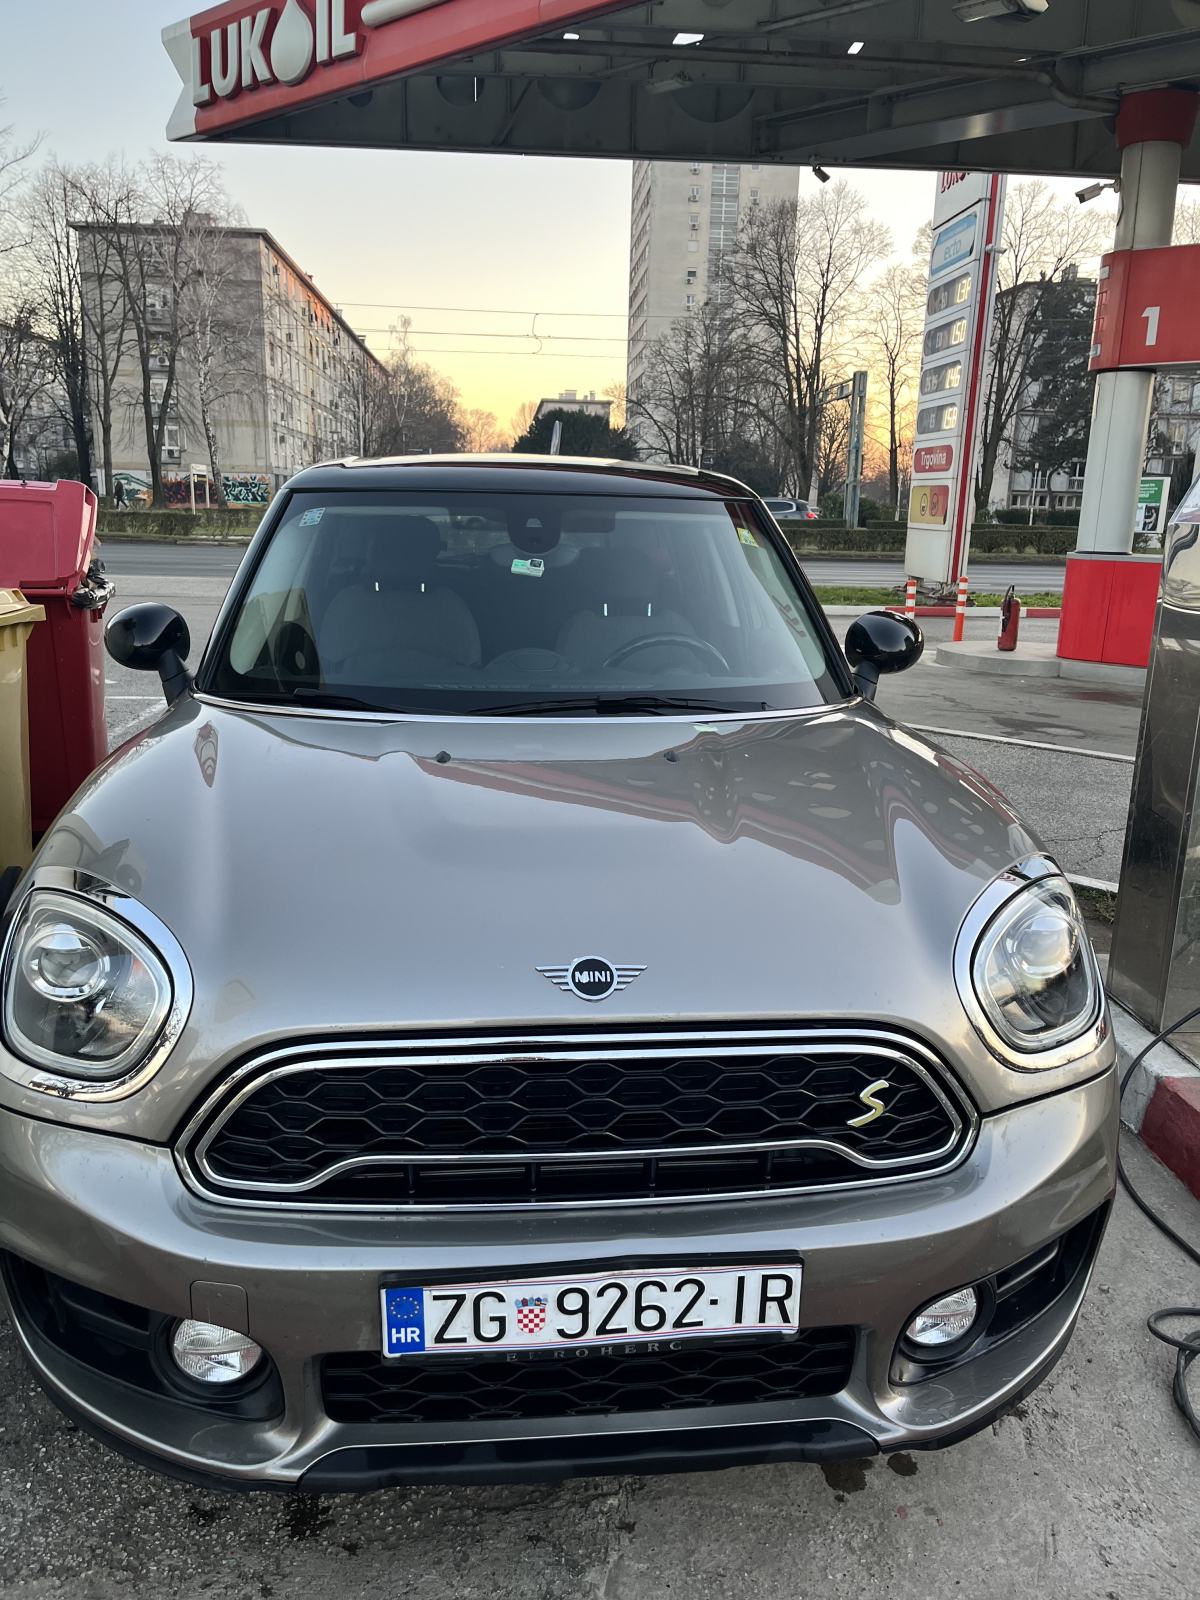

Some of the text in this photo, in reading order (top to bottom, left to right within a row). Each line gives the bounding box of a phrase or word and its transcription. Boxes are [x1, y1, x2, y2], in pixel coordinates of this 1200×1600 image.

[193, 0, 358, 105] LUKOIL
[1141, 306, 1160, 346] 1
[921, 450, 947, 470] Trgovina
[574, 970, 611, 984] MINI
[846, 1079, 890, 1128] S
[391, 1327, 421, 1345] HR
[432, 1291, 508, 1345] ZG
